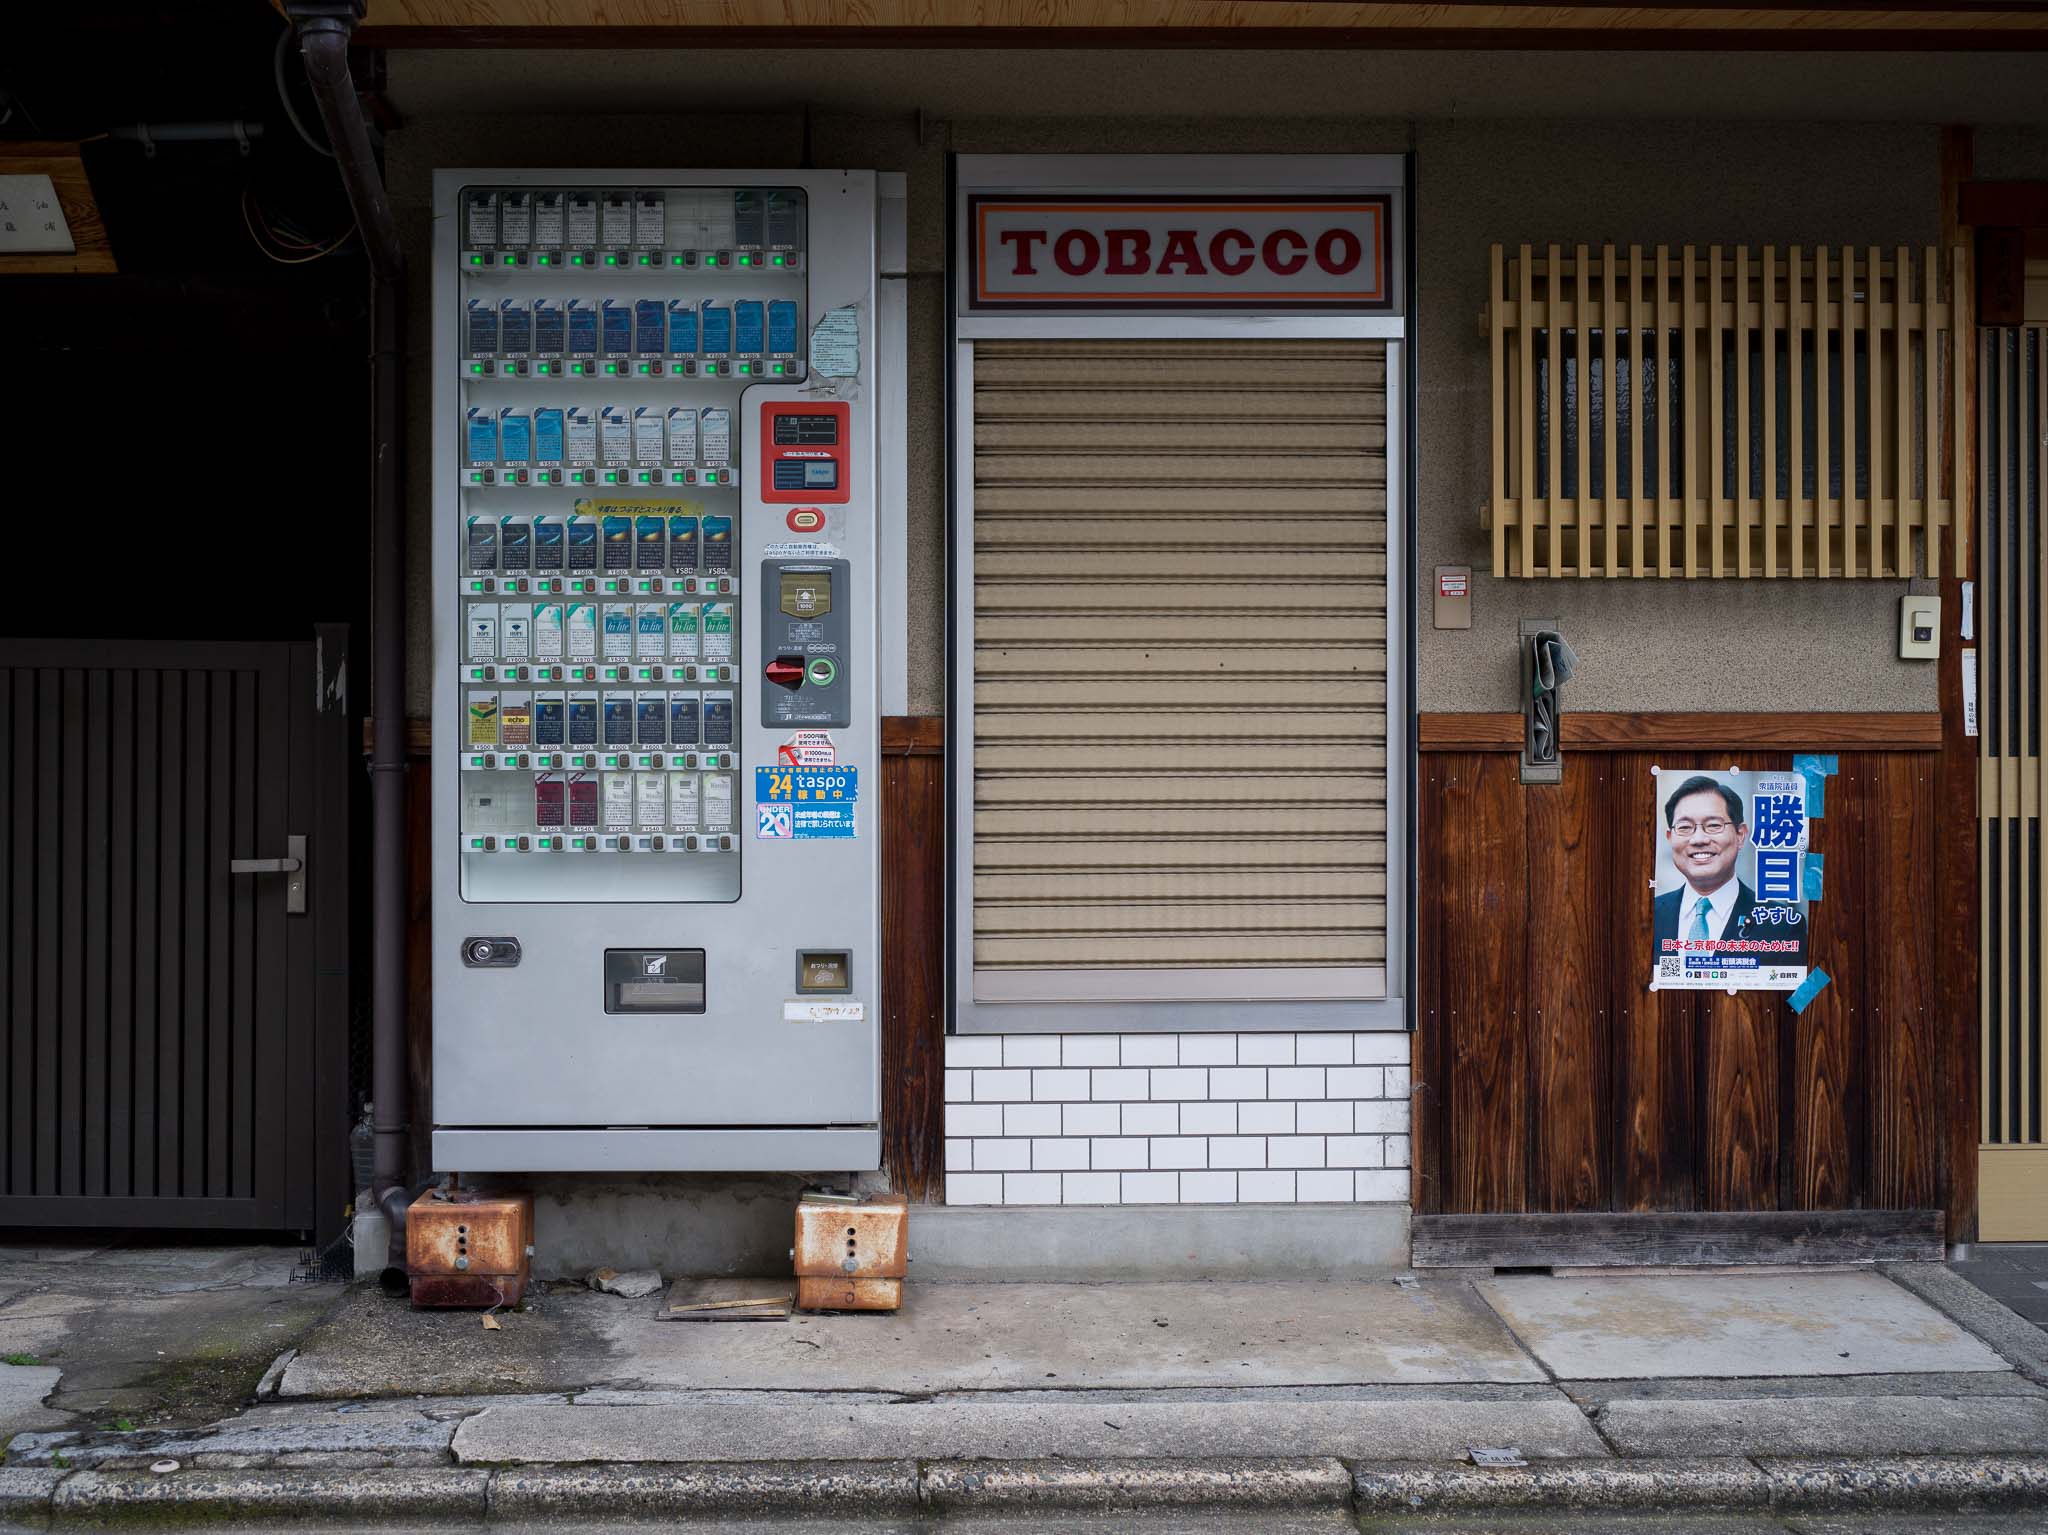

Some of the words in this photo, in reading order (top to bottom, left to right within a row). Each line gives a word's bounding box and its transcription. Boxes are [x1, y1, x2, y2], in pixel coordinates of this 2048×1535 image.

[1000, 228, 1362, 277] TOBACCO
[769, 774, 792, 794] 24
[796, 774, 846, 791] taspo
[760, 812, 790, 836] 20
[1752, 795, 1804, 902] 勝目
[1752, 906, 1802, 925] やすし
